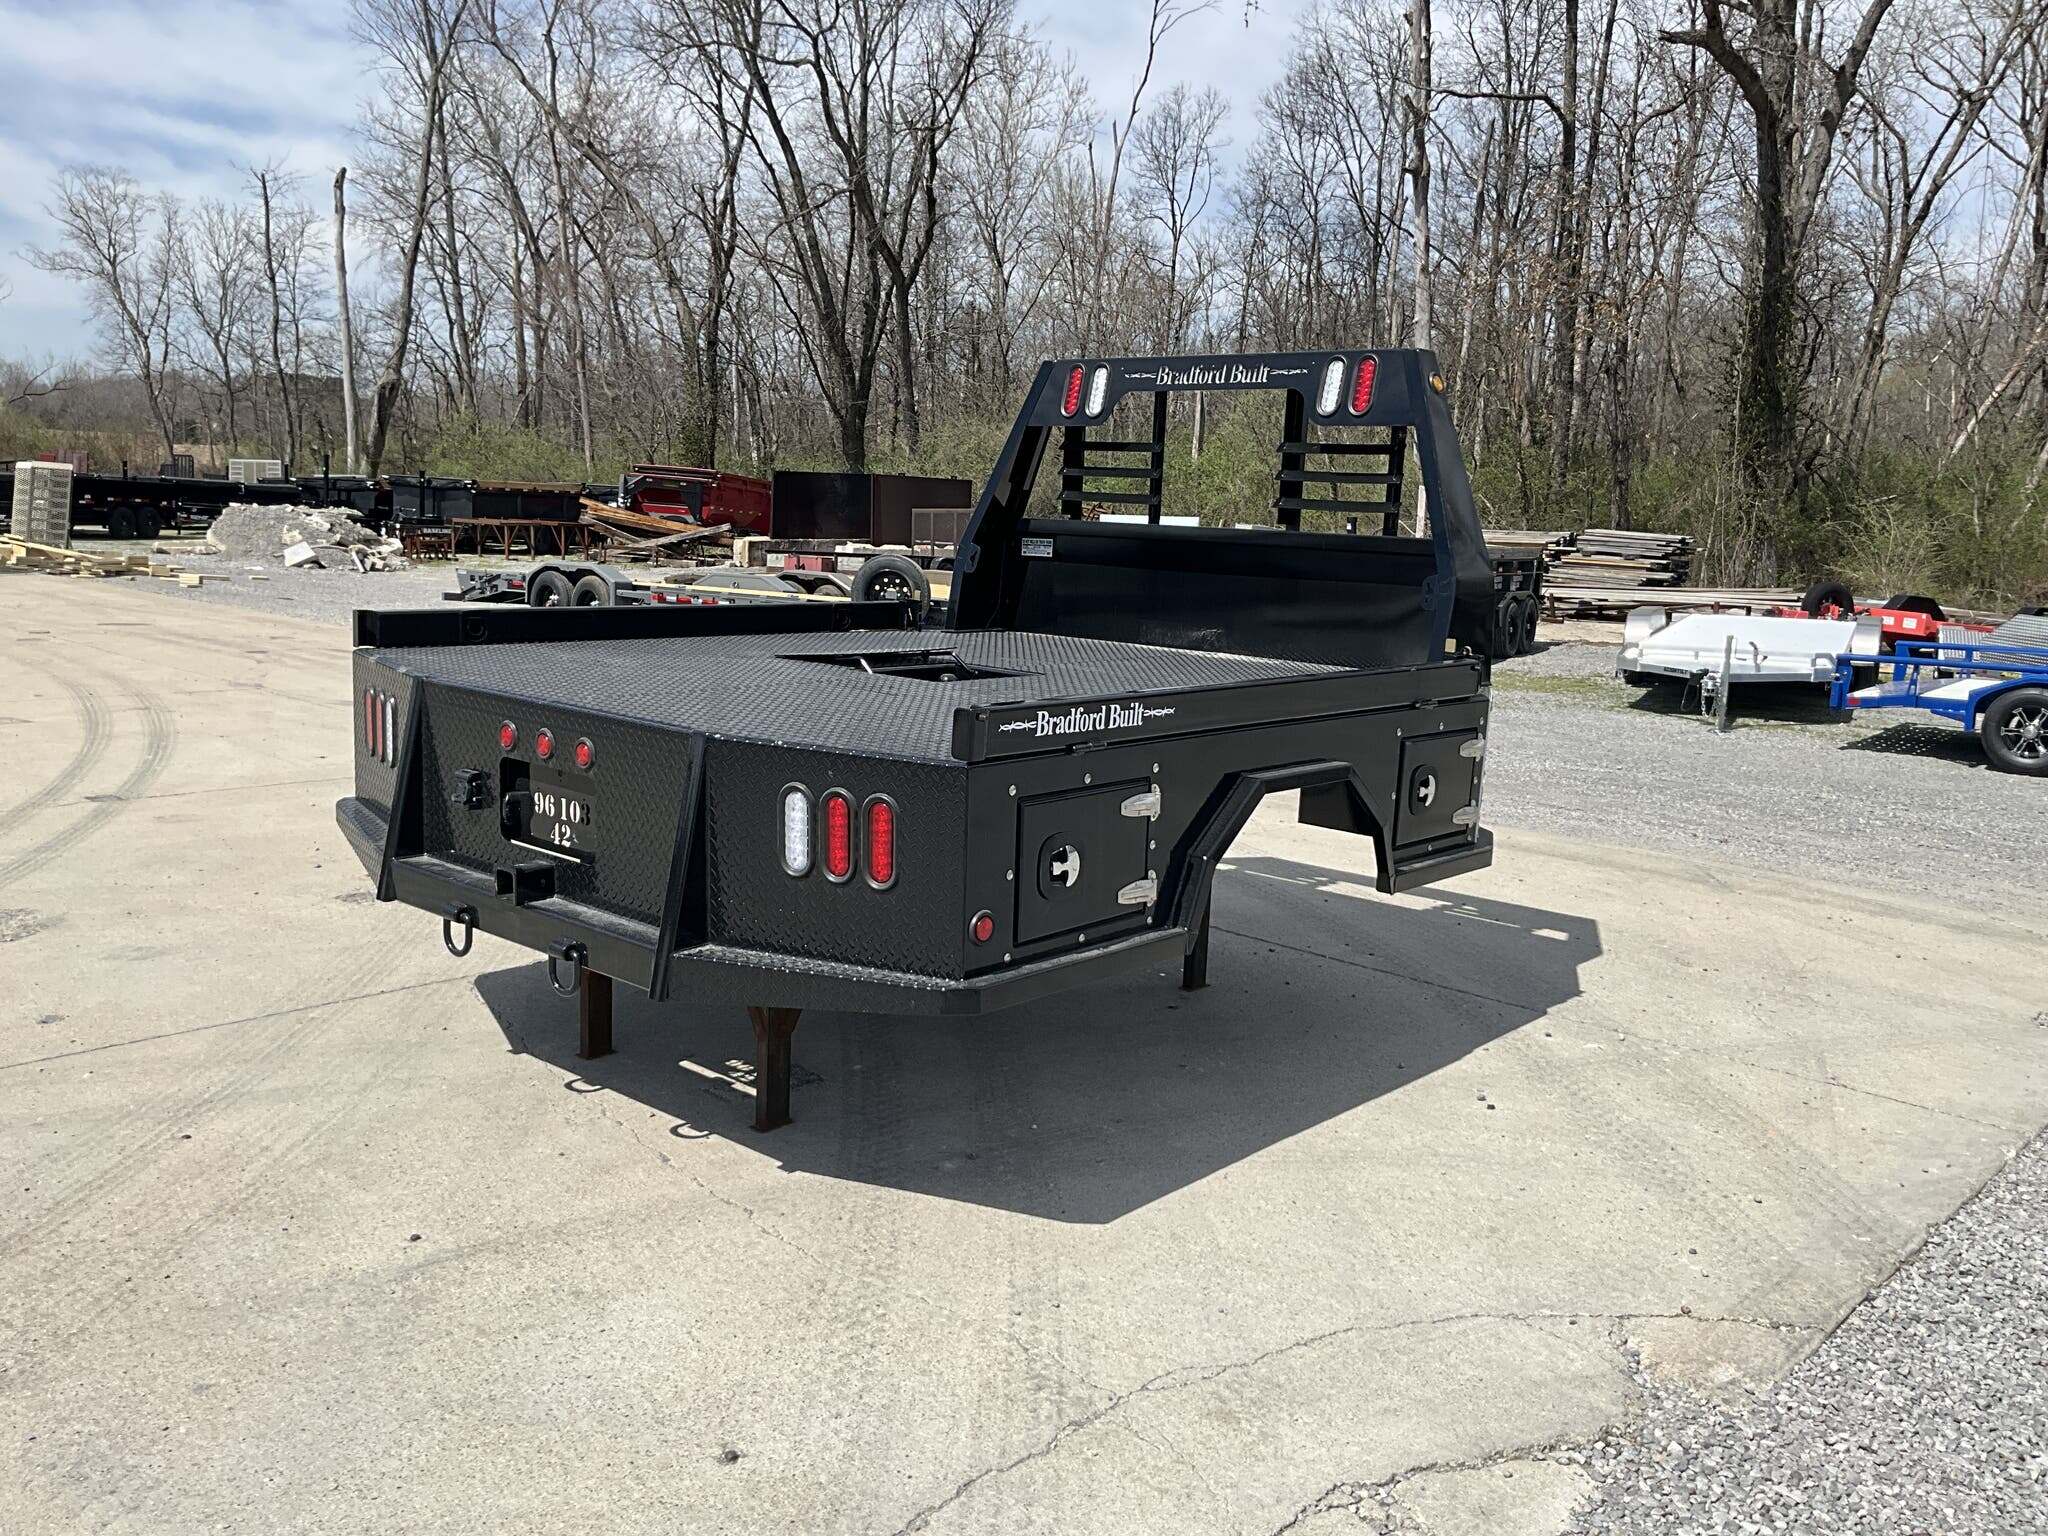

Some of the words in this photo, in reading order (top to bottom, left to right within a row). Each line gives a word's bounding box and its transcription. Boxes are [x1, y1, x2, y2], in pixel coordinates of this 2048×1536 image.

[1155, 363, 1228, 386] Bradford
[1230, 361, 1270, 384] Built
[1034, 704, 1107, 737] Bradford
[1108, 702, 1144, 729] Built
[533, 791, 556, 817] 96
[550, 822, 571, 848] 42
